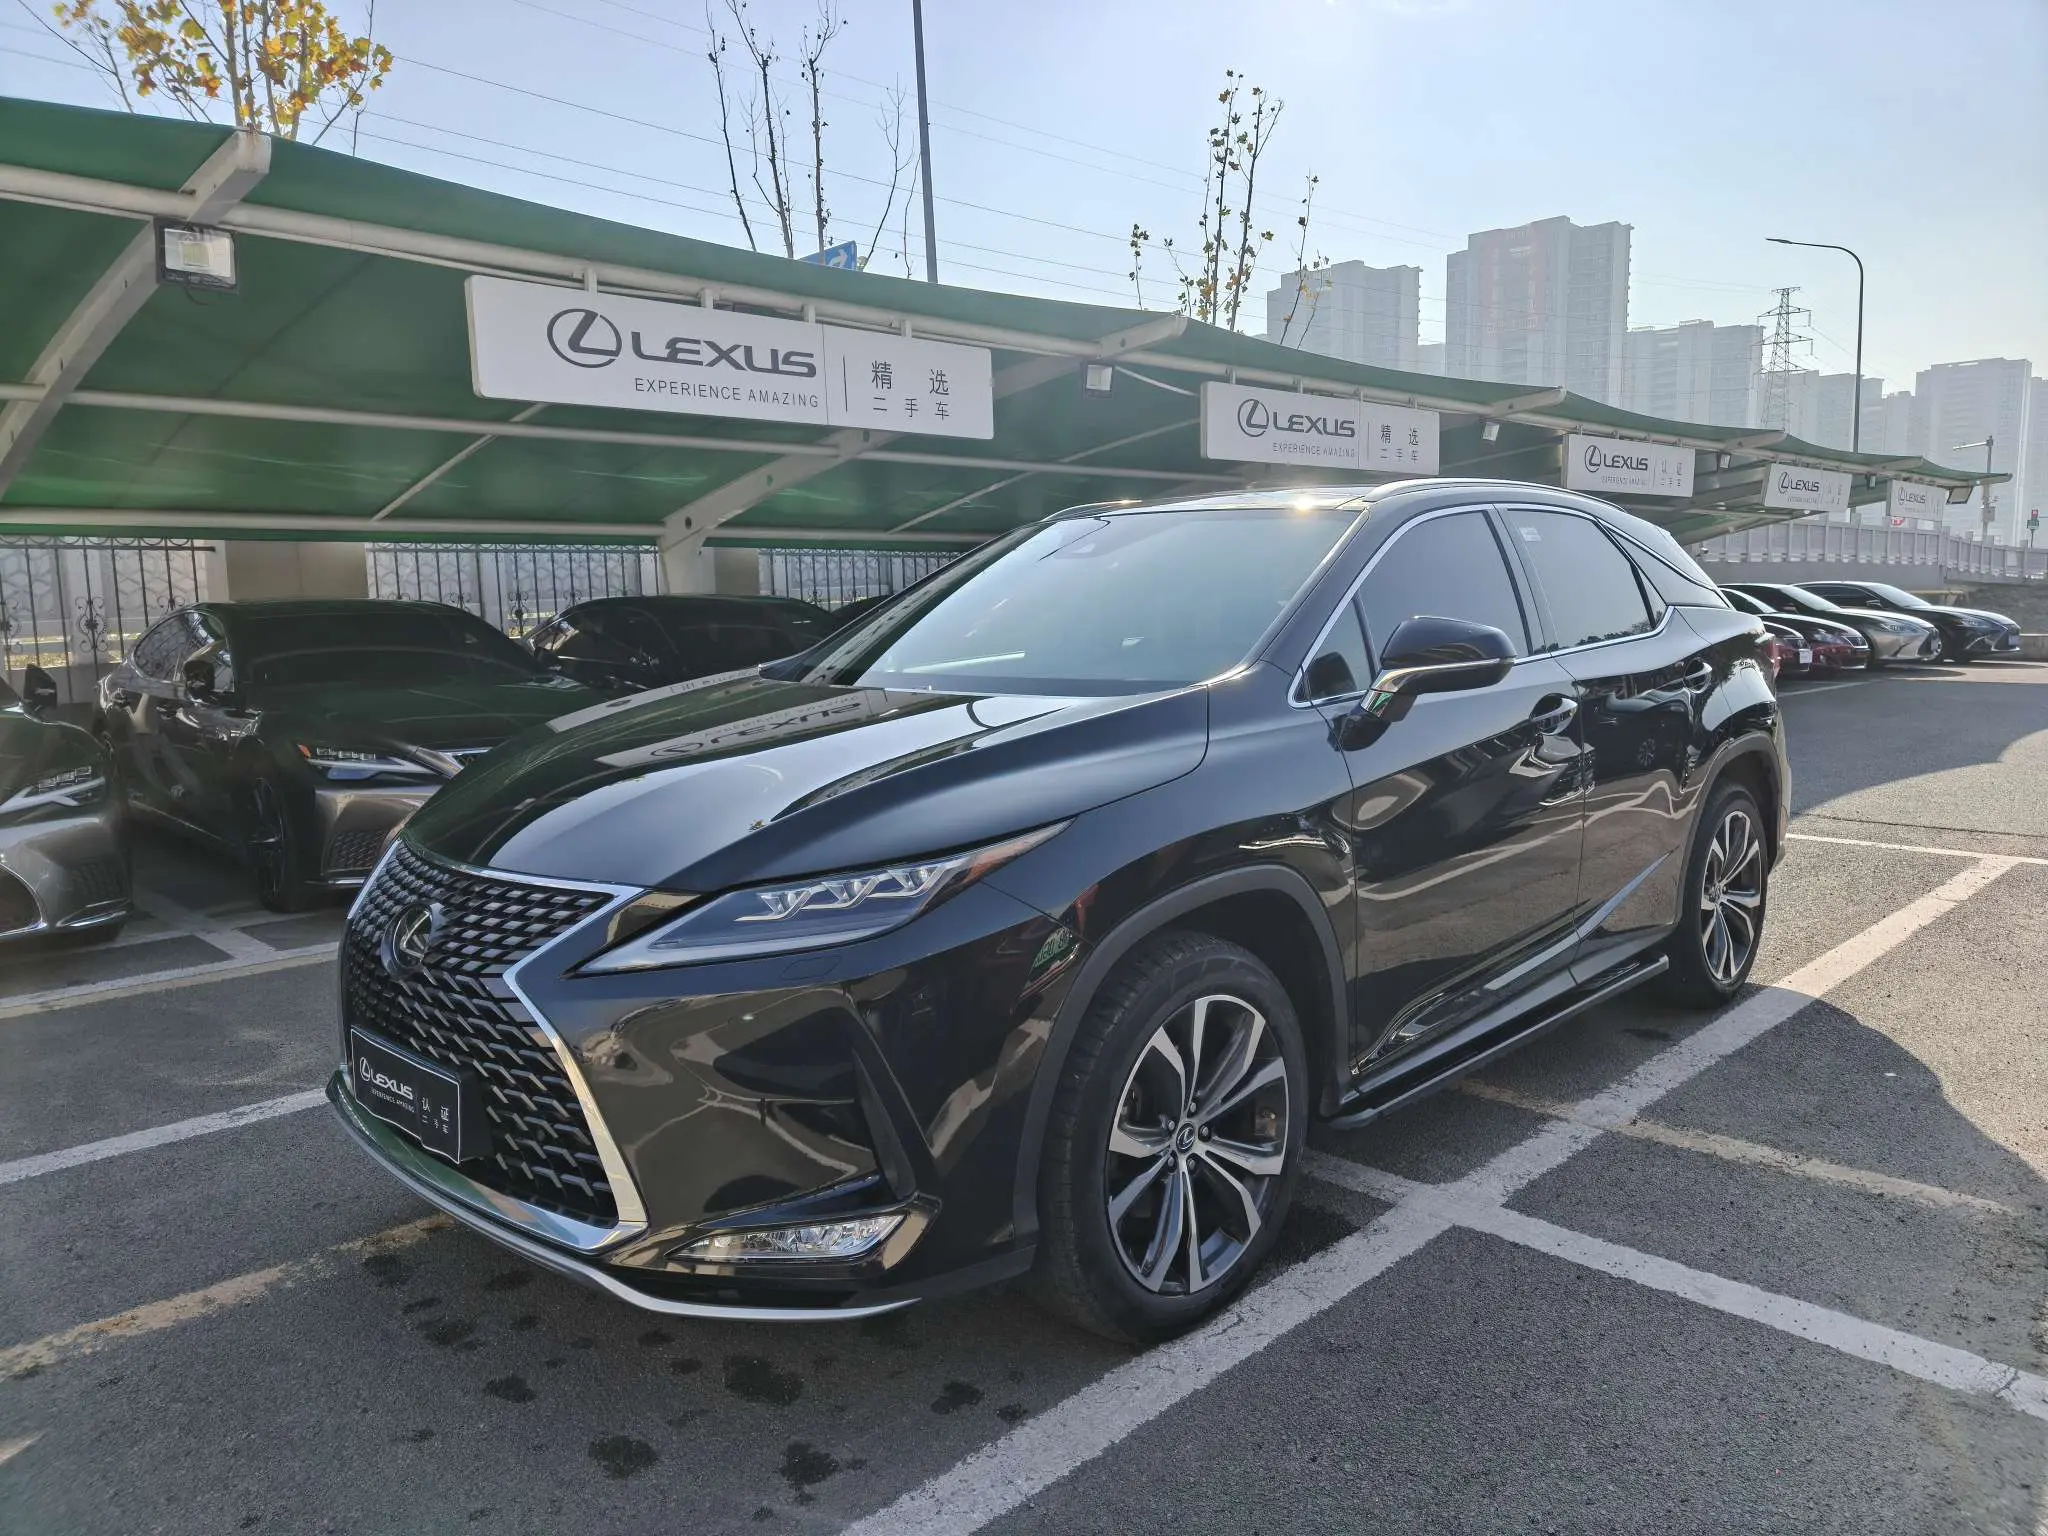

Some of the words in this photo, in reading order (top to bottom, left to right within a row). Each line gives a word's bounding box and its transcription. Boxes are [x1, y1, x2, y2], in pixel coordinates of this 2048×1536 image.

[631, 331, 817, 378] LEXUS
[871, 360, 950, 396] 精选
[634, 377, 742, 401] EXPERIENCE
[748, 388, 819, 408] AMAZING
[872, 397, 950, 420] 二手车
[1273, 411, 1355, 437] LEXUS
[1603, 454, 1648, 471] LEXUS
[1790, 478, 1820, 492] LEXUS
[370, 1068, 414, 1100] LEXUS
